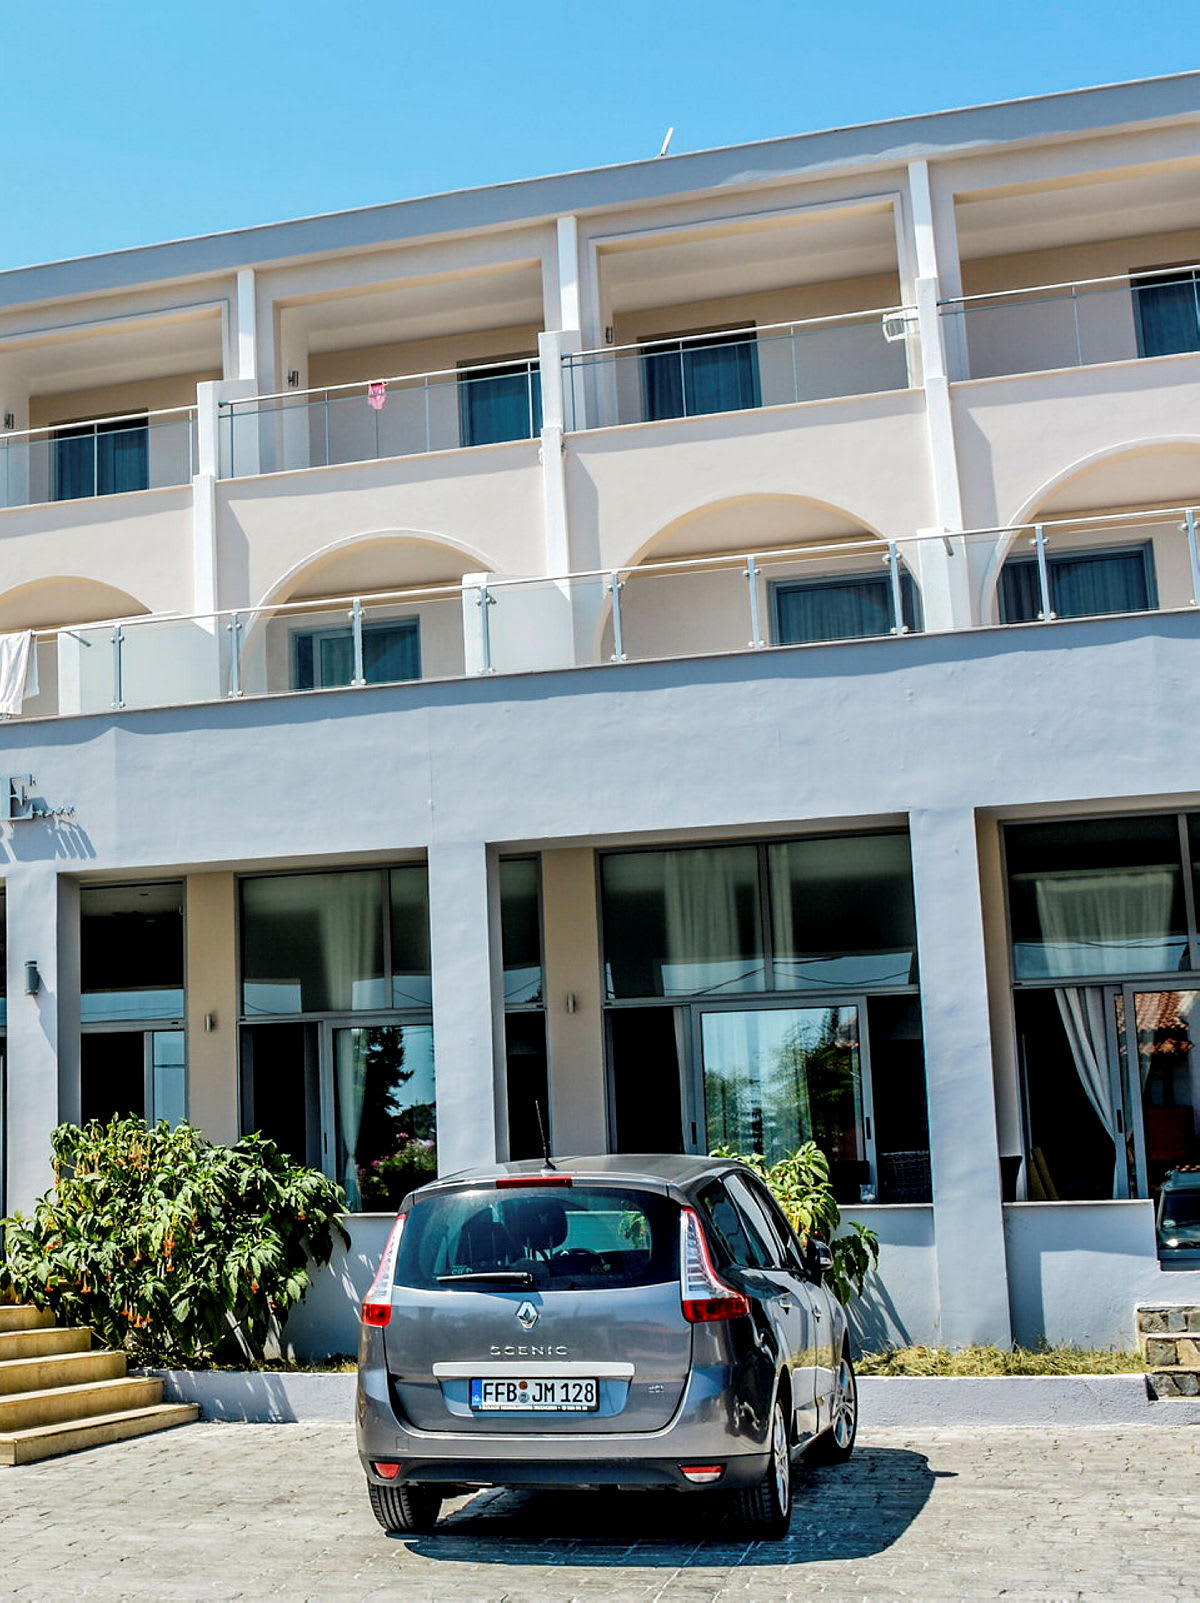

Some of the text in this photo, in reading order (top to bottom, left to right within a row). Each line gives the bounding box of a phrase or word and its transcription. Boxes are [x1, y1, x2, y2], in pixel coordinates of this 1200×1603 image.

[490, 1345, 568, 1356] SCENIC
[483, 1382, 594, 1403] FFB JM 128
